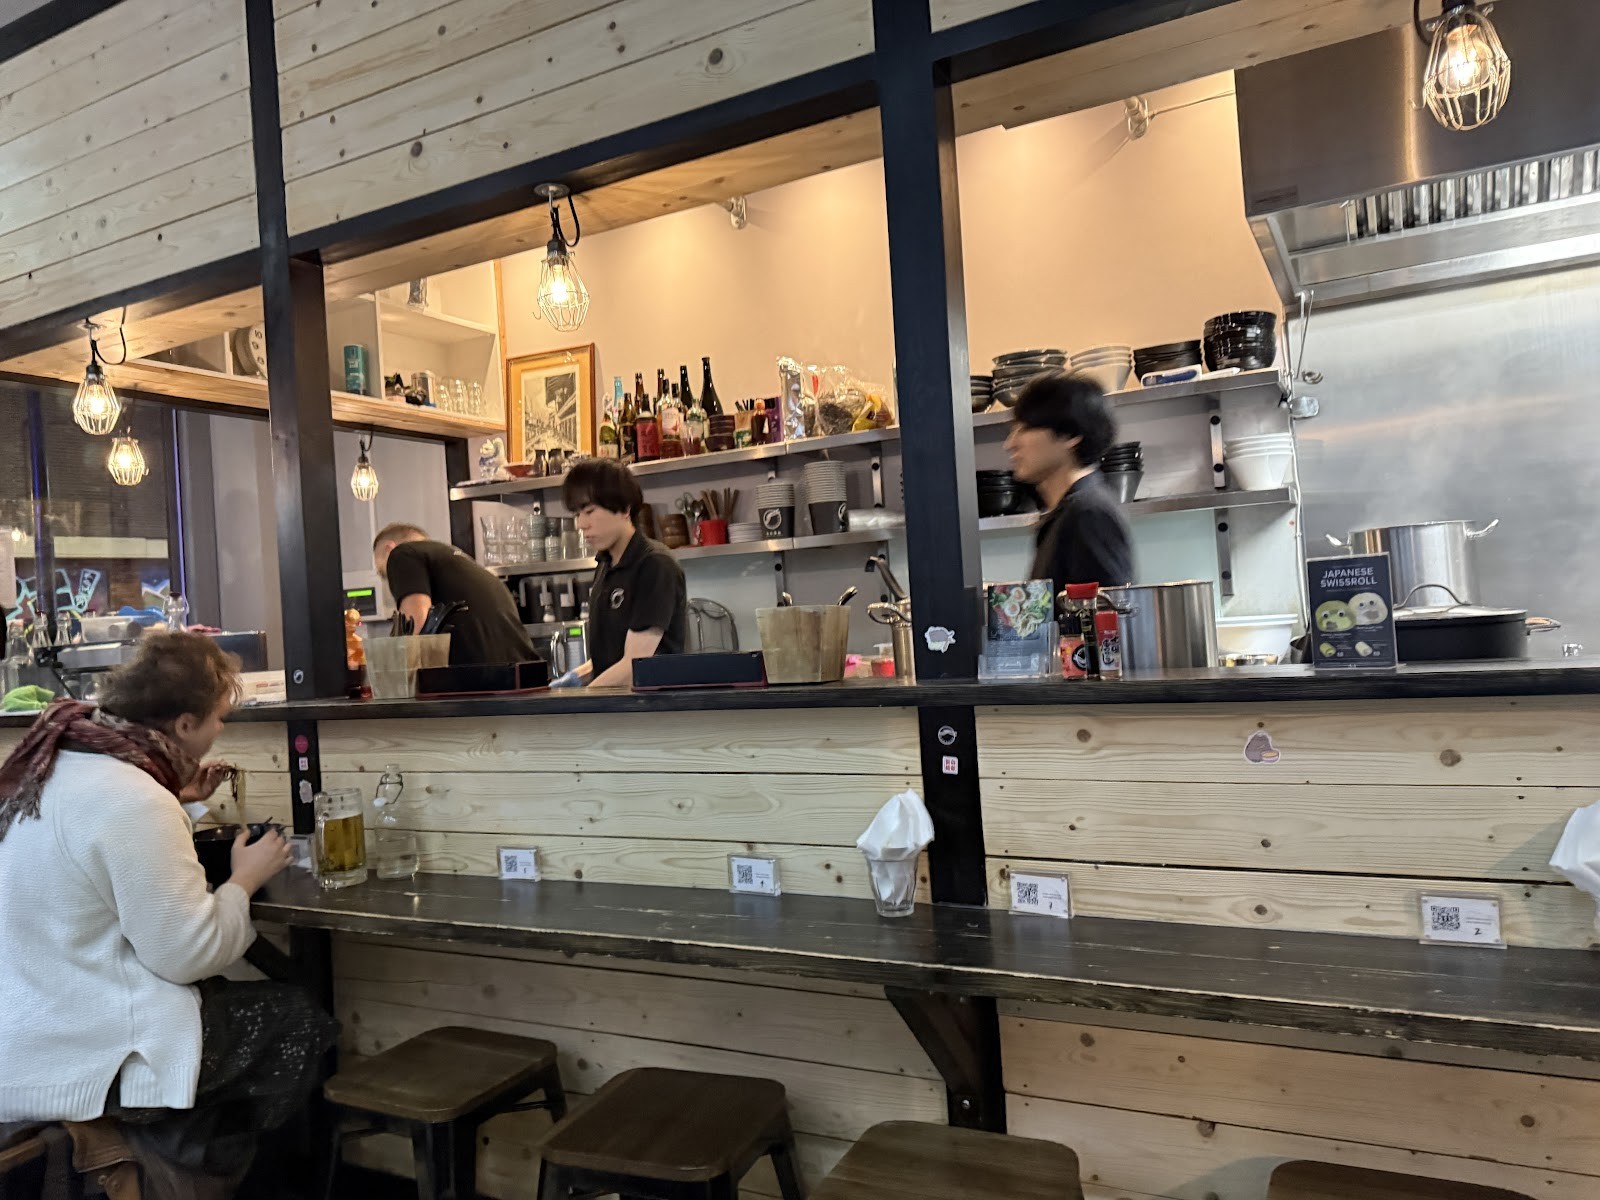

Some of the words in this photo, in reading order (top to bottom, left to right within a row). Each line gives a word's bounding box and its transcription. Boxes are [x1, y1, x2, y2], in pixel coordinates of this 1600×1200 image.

[1322, 567, 1374, 578] JAPANESE
[1320, 576, 1378, 588] SWISSROLL
[1474, 927, 1482, 936] 2
